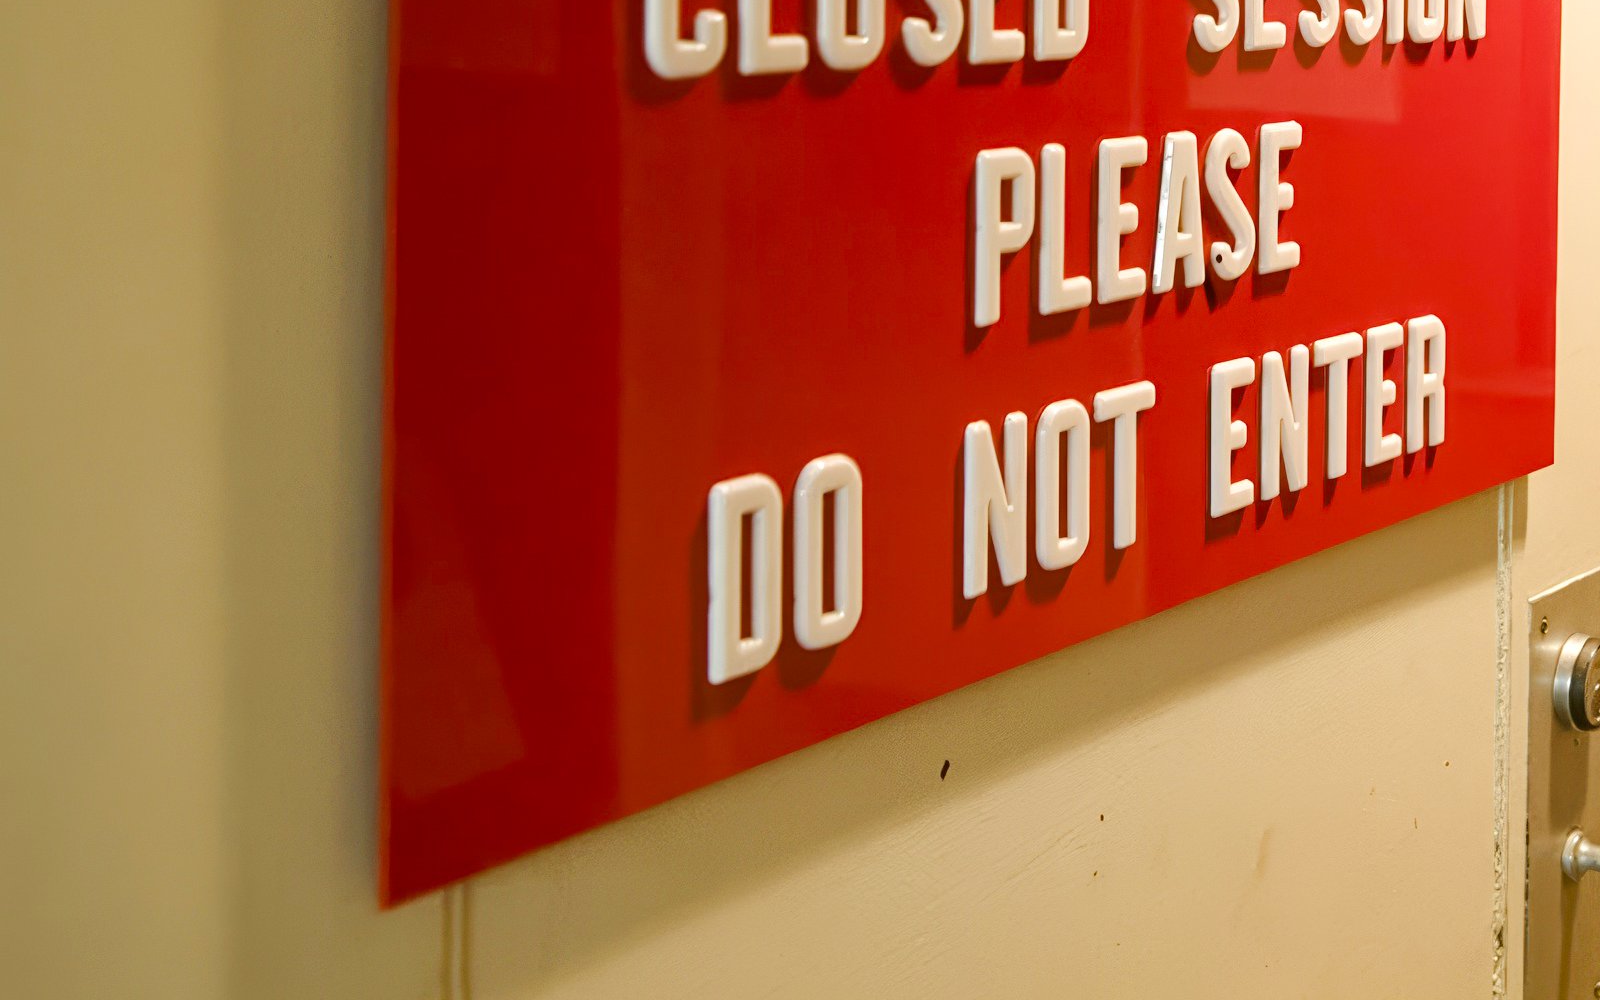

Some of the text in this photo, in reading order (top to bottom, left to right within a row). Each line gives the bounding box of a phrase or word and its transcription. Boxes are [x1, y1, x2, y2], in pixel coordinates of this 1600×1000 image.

[973, 119, 1304, 328] PLEASE
[706, 313, 1448, 685] DO NOT ENTER
